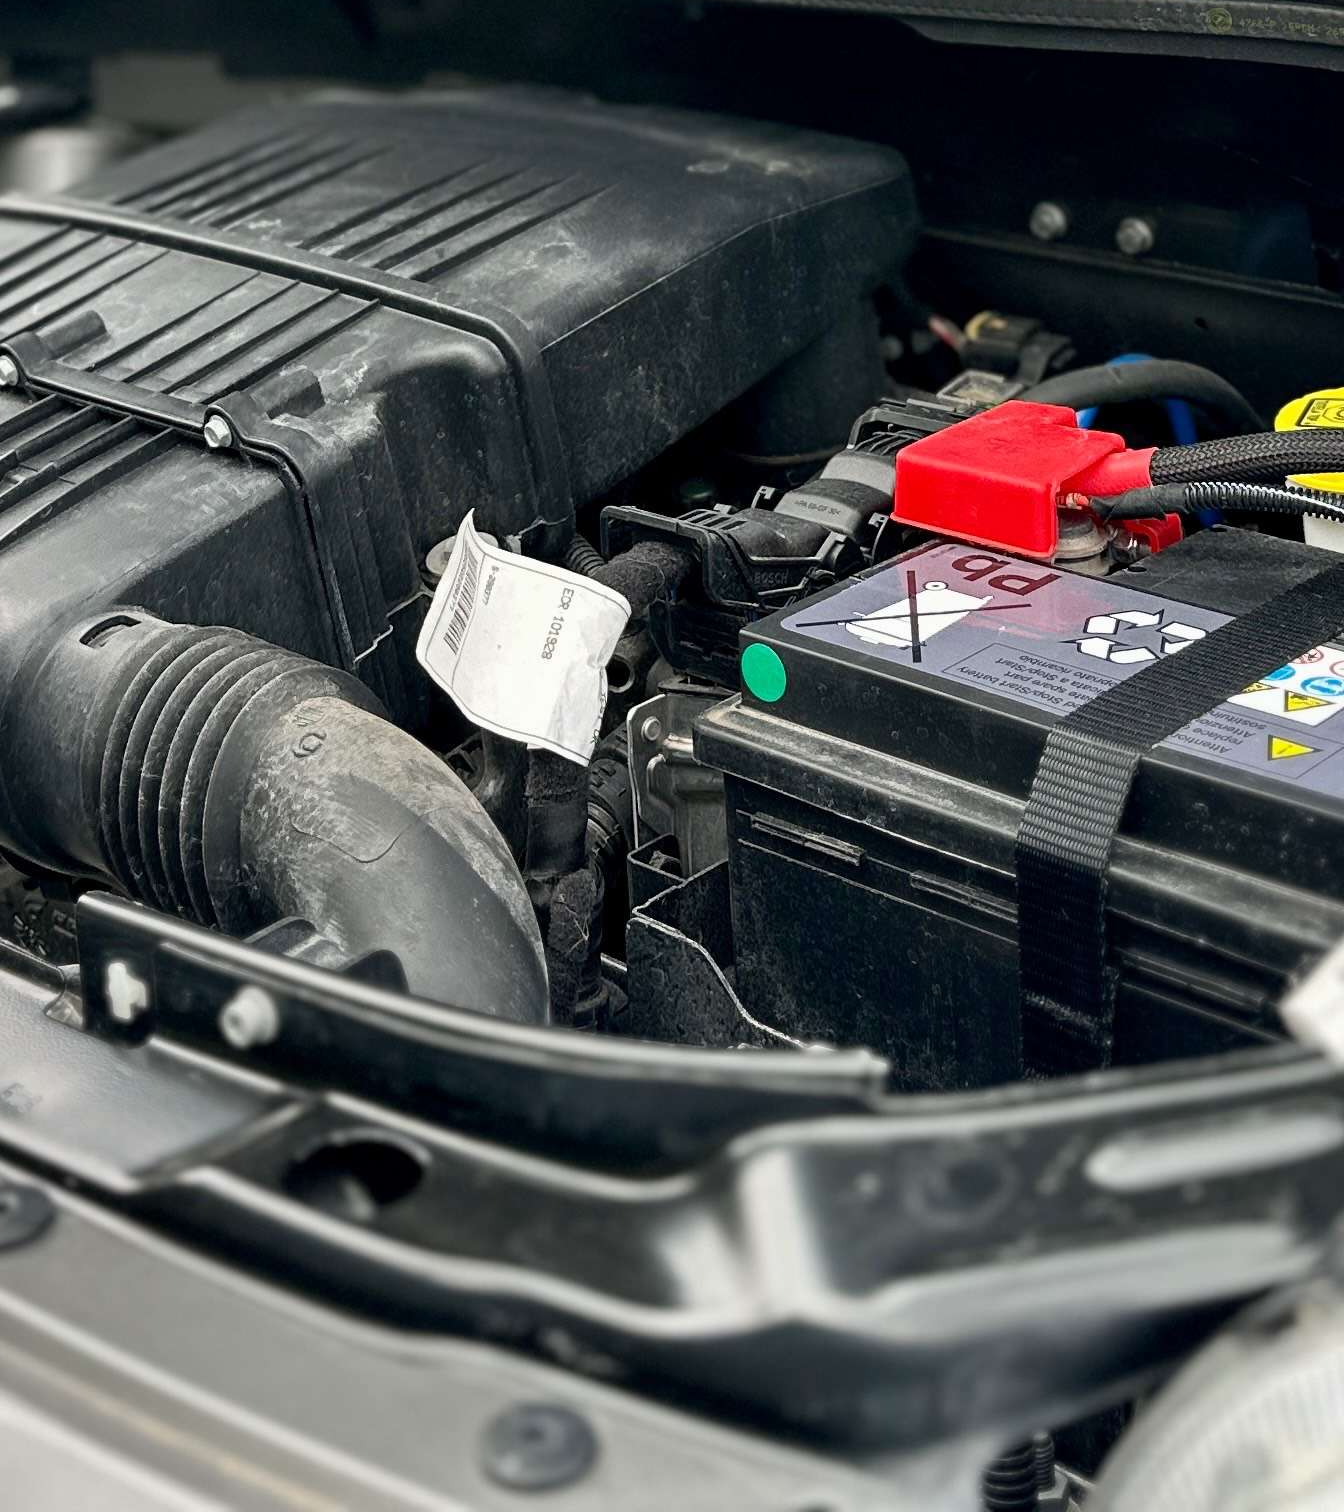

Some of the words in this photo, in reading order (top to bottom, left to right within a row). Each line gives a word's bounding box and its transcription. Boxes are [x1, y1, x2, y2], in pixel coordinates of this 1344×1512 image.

[952, 555, 1062, 596] Pb
[558, 588, 575, 610] ECR
[541, 616, 564, 660] 101928
[1019, 655, 1071, 674] ricambio
[957, 666, 999, 684] battery
[1003, 670, 1032, 682] part
[1032, 679, 1067, 693] spare
[1192, 728, 1243, 746] replace
